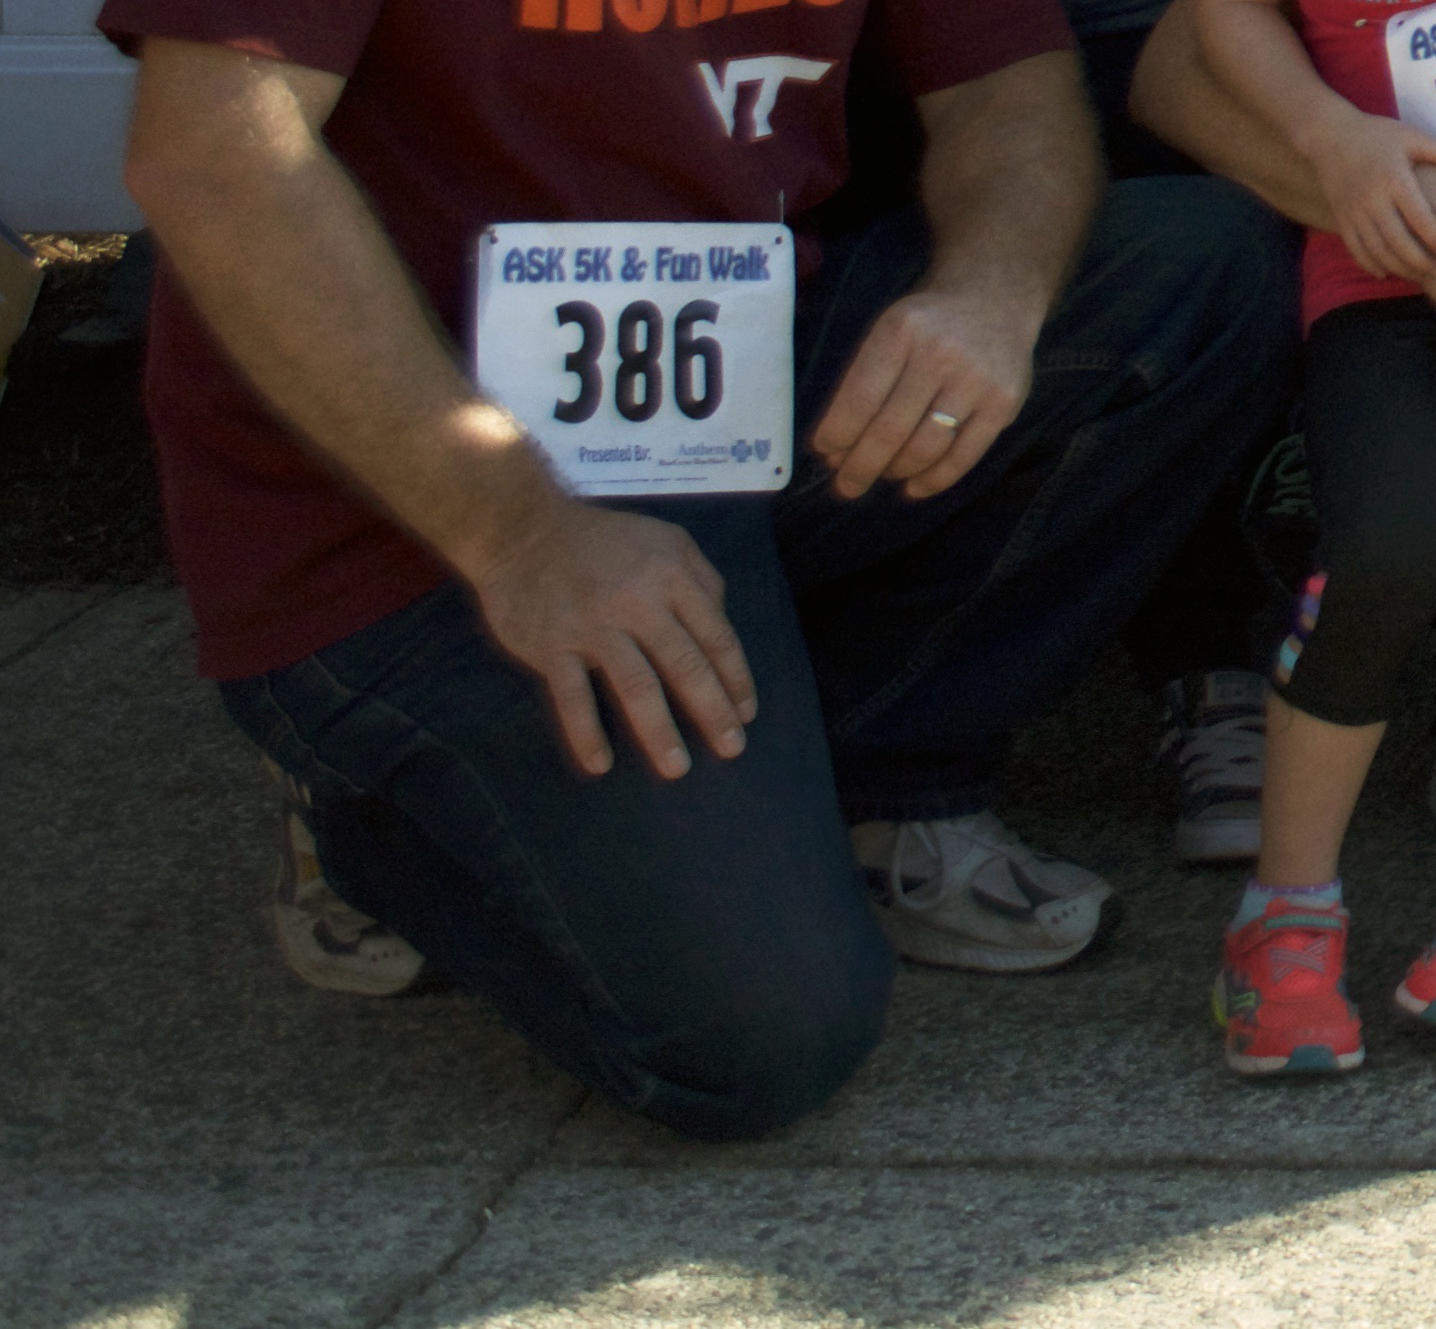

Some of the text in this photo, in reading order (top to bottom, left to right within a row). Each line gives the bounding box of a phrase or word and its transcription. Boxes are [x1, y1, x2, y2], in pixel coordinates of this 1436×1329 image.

[503, 245, 772, 283] ASK 5K & Fun Walk
[553, 298, 724, 425] 386
[579, 445, 632, 462] Presented
